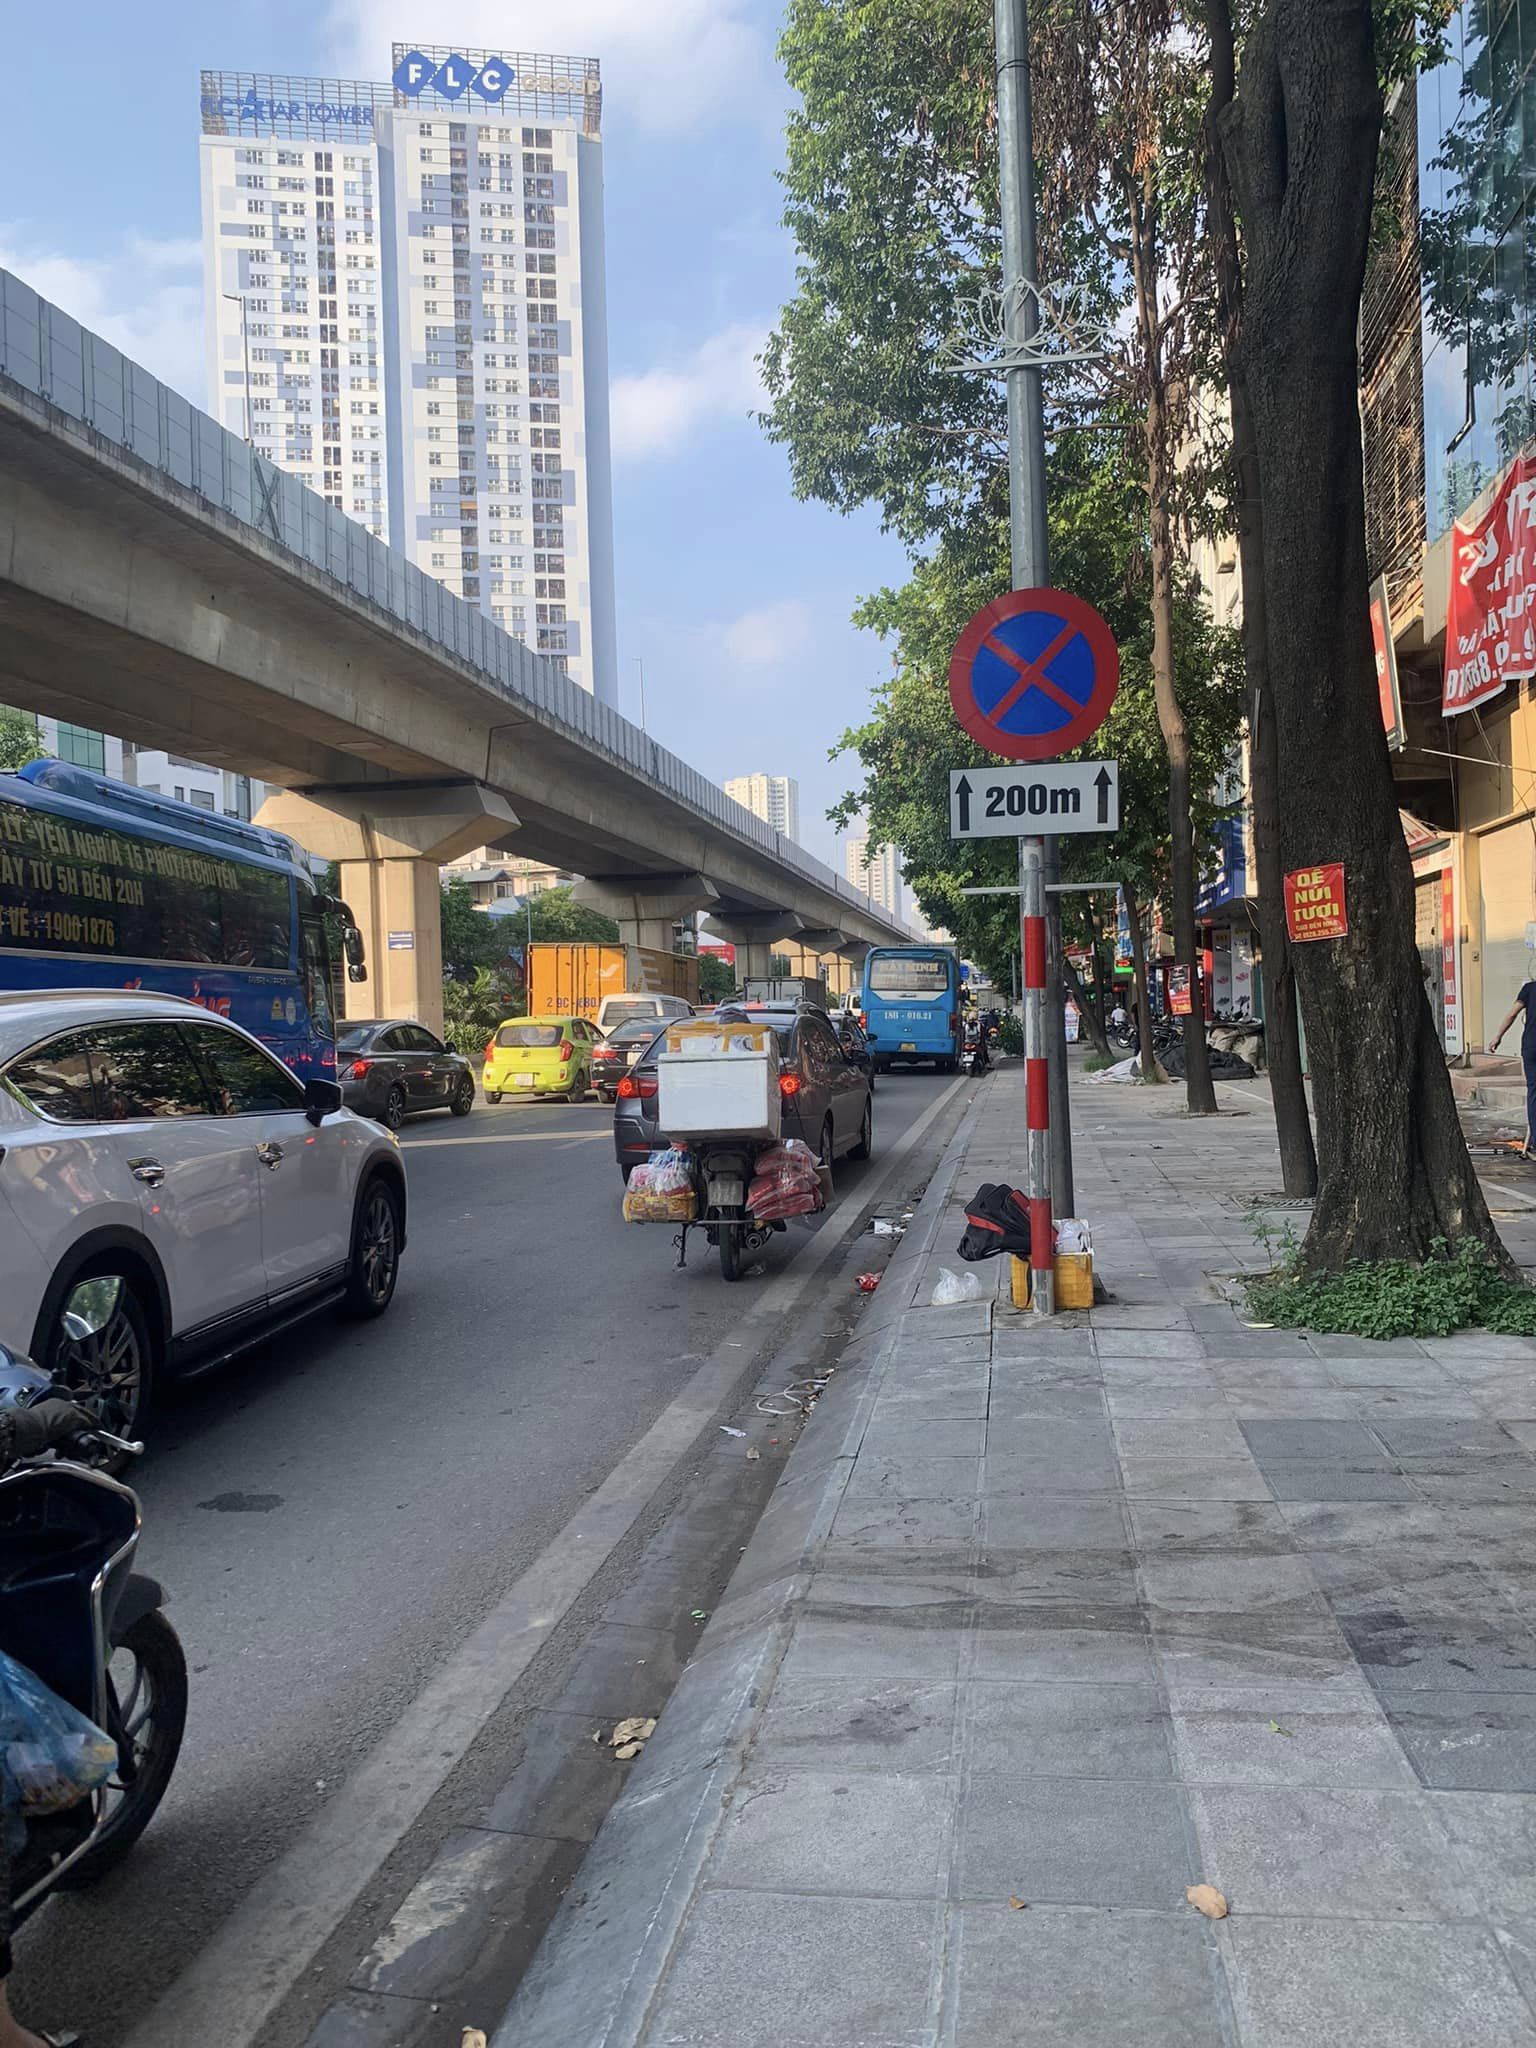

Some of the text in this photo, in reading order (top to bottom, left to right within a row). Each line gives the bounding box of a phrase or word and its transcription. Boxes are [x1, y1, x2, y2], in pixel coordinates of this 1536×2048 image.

[408, 63, 600, 96] FLC GROUP
[985, 783, 1081, 818] 200m
[56, 866, 79, 896] 5H
[81, 866, 113, 901] ĐẾN
[115, 878, 144, 906] 20H
[1294, 885, 1332, 905] NÚI
